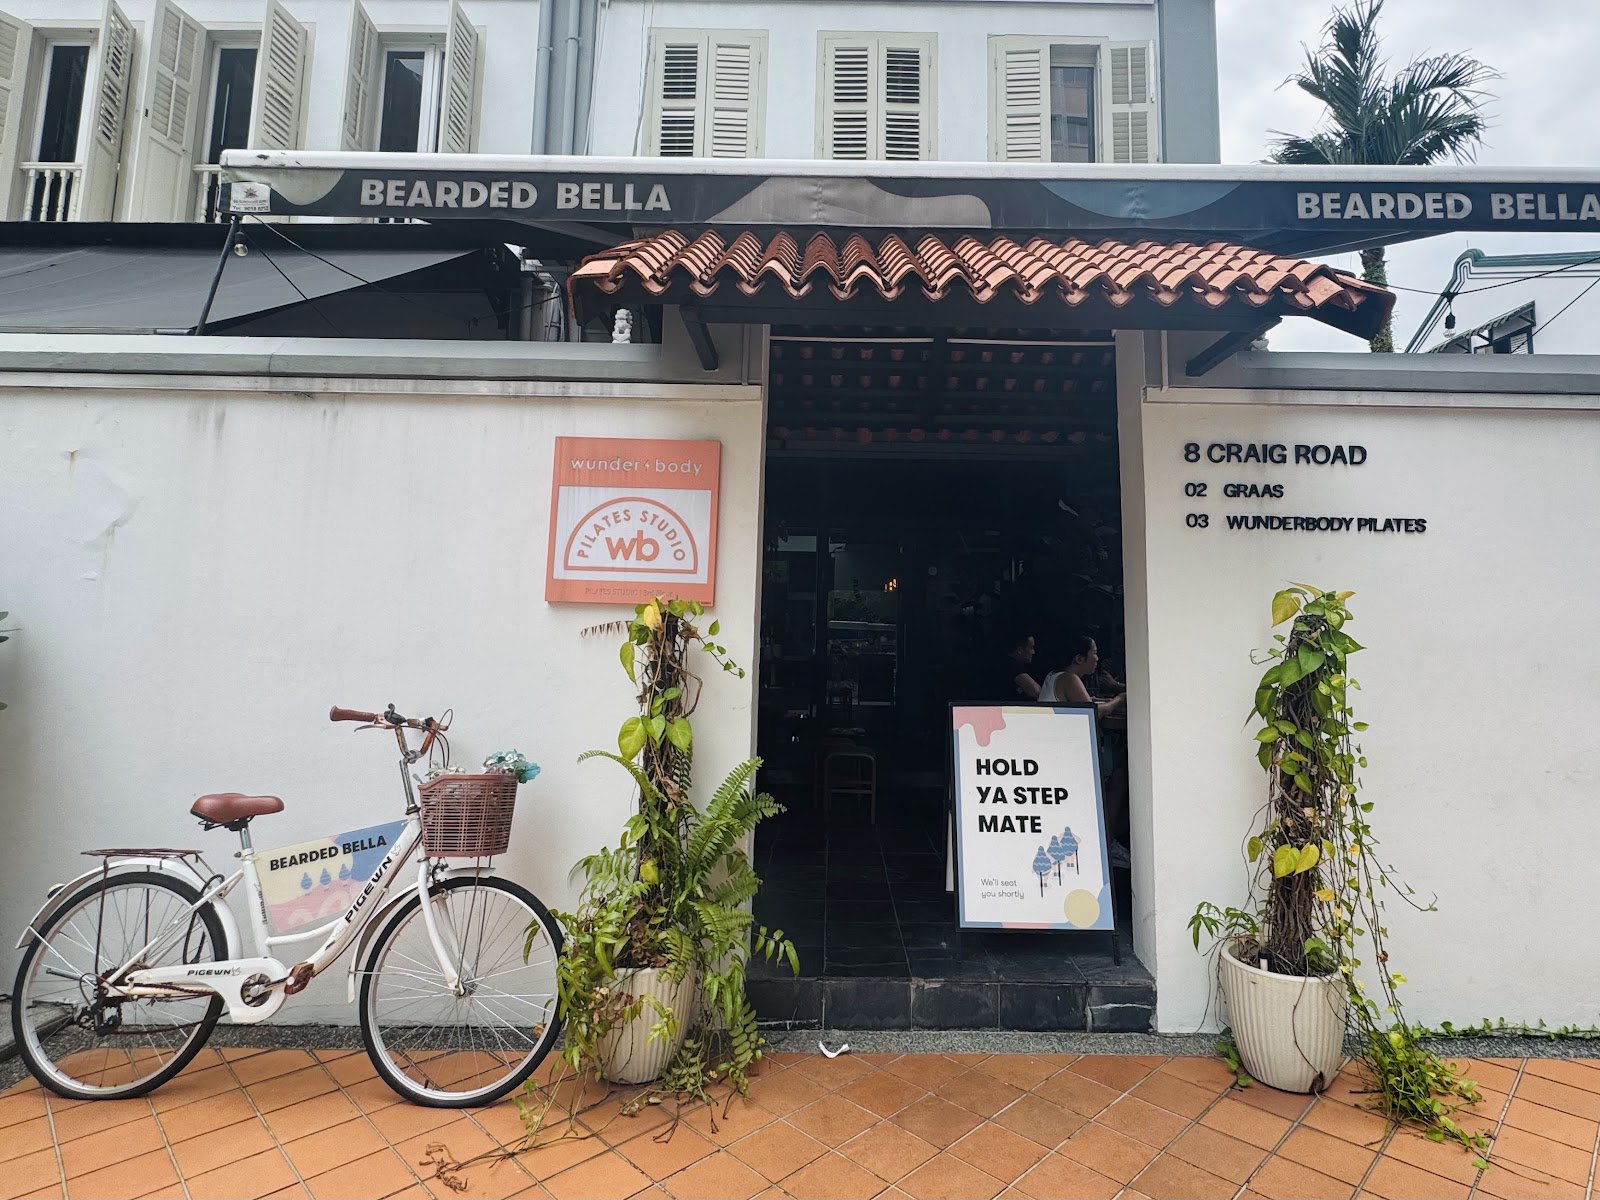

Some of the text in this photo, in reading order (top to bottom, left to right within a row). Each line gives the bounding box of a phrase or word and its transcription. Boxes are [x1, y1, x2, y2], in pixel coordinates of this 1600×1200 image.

[361, 179, 672, 212] BEARDED BELLA
[1297, 192, 1600, 221] BEARDED BELLA
[1184, 442, 1368, 466] 8 CRAIG ROAD
[571, 457, 703, 477] wunder body
[1184, 482, 1285, 499] 02 GRAAS
[1185, 513, 1428, 533] 03 WUNDERBODY PILATES
[577, 509, 686, 561] PILATES STUDIO
[605, 529, 660, 561] wb
[976, 758, 1039, 776] HOLD
[977, 786, 1069, 805] YA STEP
[978, 815, 1042, 833] MATE
[270, 835, 388, 871] BEARDED BELLA
[345, 855, 393, 924] PIGEWN
[981, 878, 1018, 887] We'll seat
[981, 890, 1025, 900] you shortly
